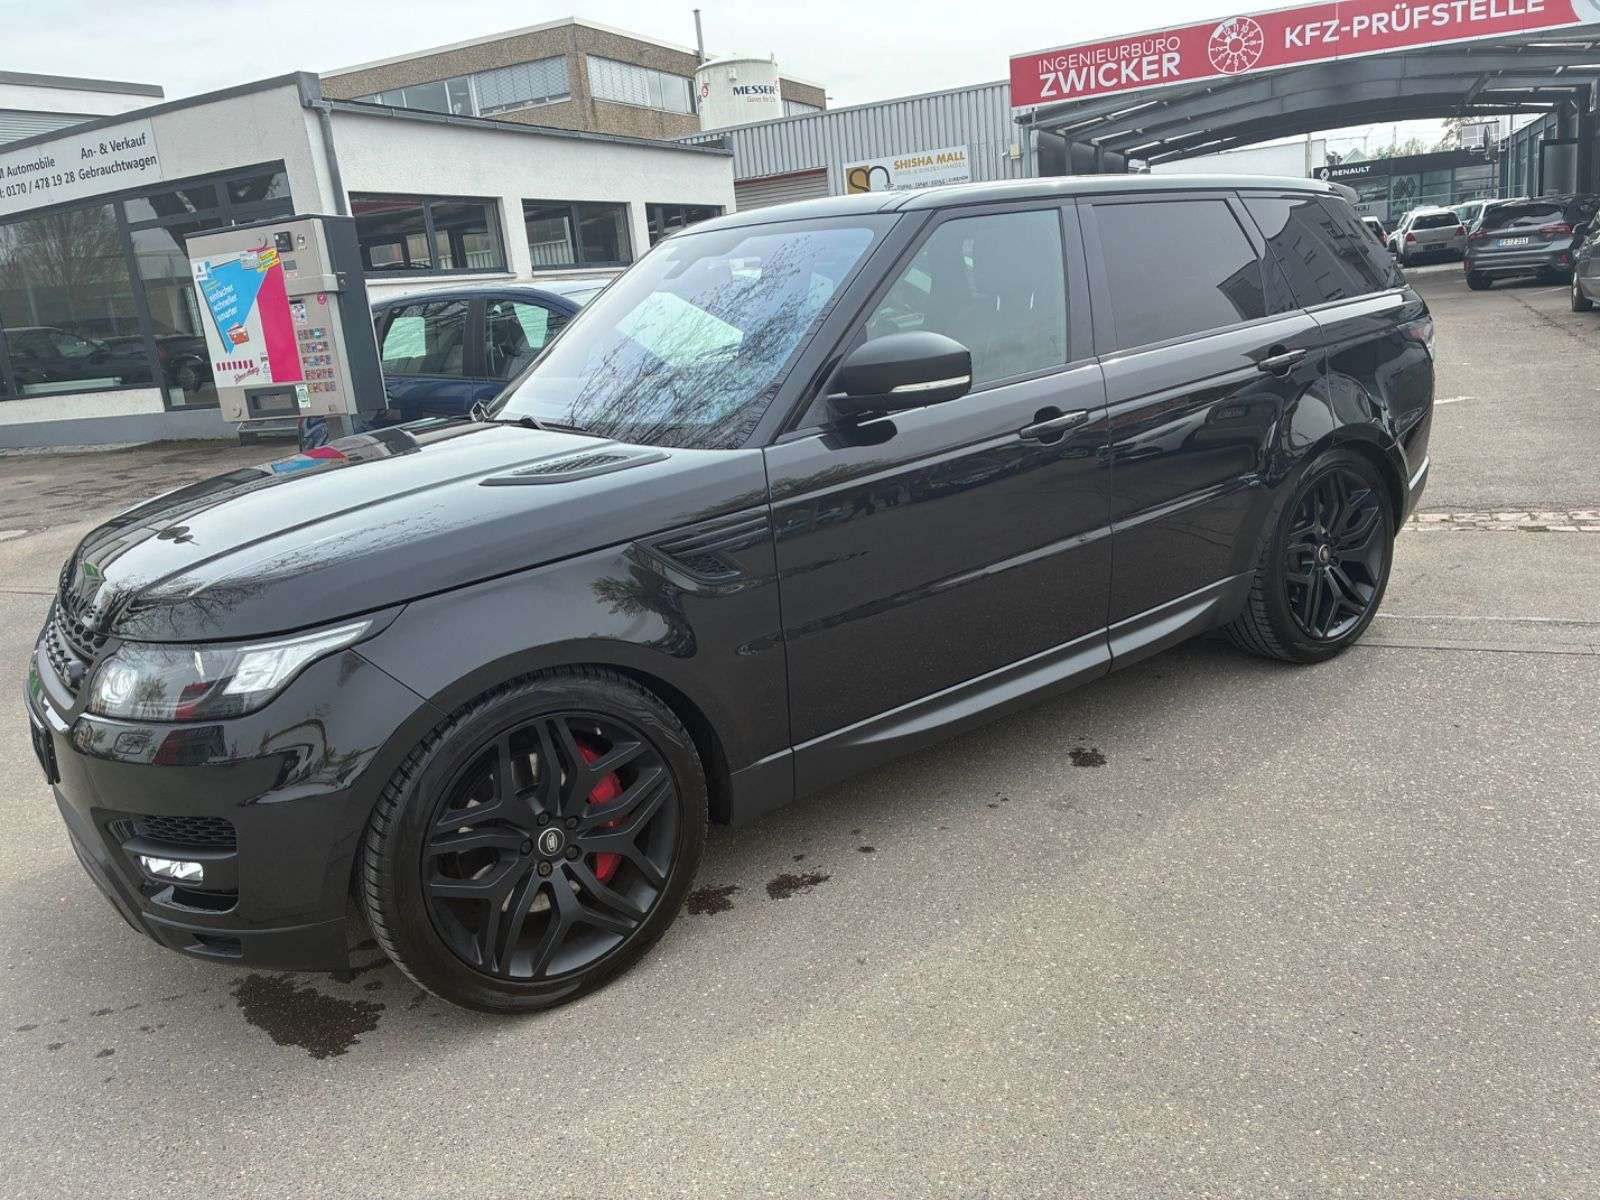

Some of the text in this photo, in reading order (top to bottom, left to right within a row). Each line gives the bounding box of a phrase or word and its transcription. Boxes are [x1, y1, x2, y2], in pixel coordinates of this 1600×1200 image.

[1284, 0, 1545, 48] KFZ-PRÜFSTELLE
[1038, 36, 1181, 73] INGENIEURBÜRO
[1039, 52, 1181, 98] ZWICKER
[732, 84, 776, 96] MESSER
[80, 132, 146, 160] An- & Verkauf
[7, 155, 56, 178] Automobile
[78, 155, 157, 180] Gebrauchtwagen
[893, 157, 934, 171] SHISHA
[936, 150, 966, 164] MALL
[1331, 165, 1371, 177] RENAULT
[6, 182, 27, 197] 0170
[34, 176, 51, 190] 478
[51, 174, 63, 187] 19
[64, 170, 76, 184] 28
